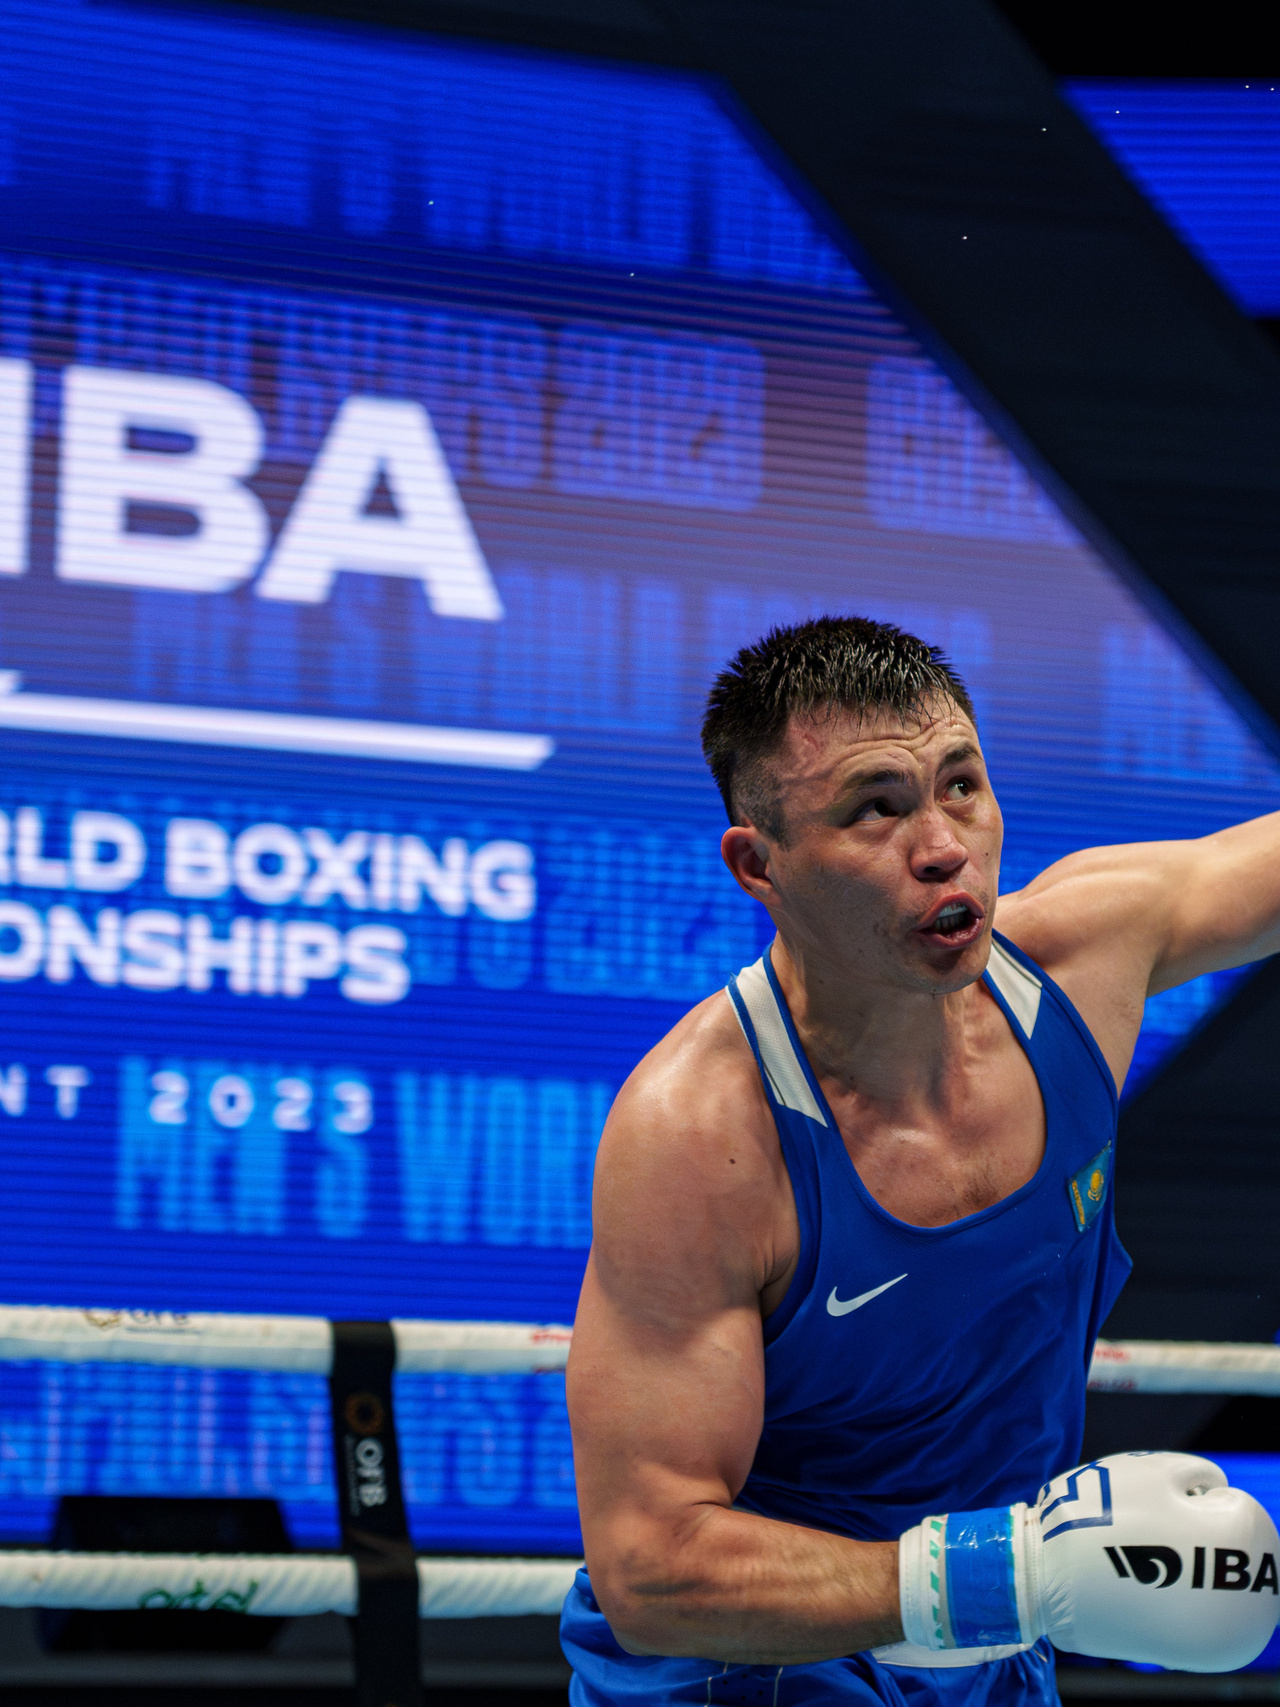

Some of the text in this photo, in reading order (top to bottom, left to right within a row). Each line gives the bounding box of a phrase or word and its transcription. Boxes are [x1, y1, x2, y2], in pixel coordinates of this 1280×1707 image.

[0, 805, 538, 922] LD BOXING
[147, 1069, 376, 1136] 2023
[1191, 1546, 1280, 1596] IBA
